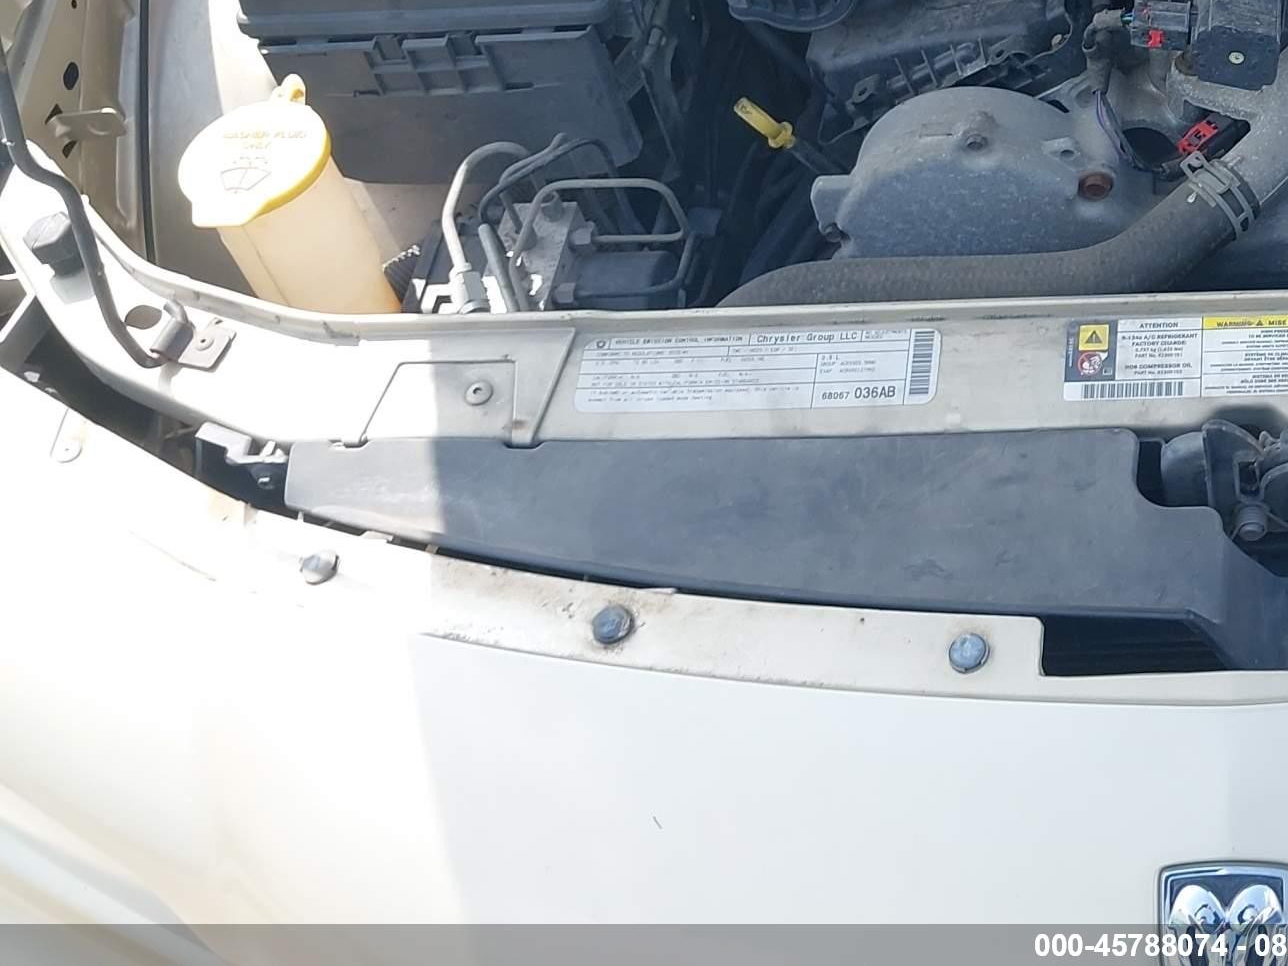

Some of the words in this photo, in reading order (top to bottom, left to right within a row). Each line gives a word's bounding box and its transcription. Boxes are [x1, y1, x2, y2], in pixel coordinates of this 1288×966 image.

[757, 334, 800, 345] Chrysler
[806, 333, 835, 344] Group
[840, 332, 857, 340] LLC
[854, 385, 896, 399] 036AB
